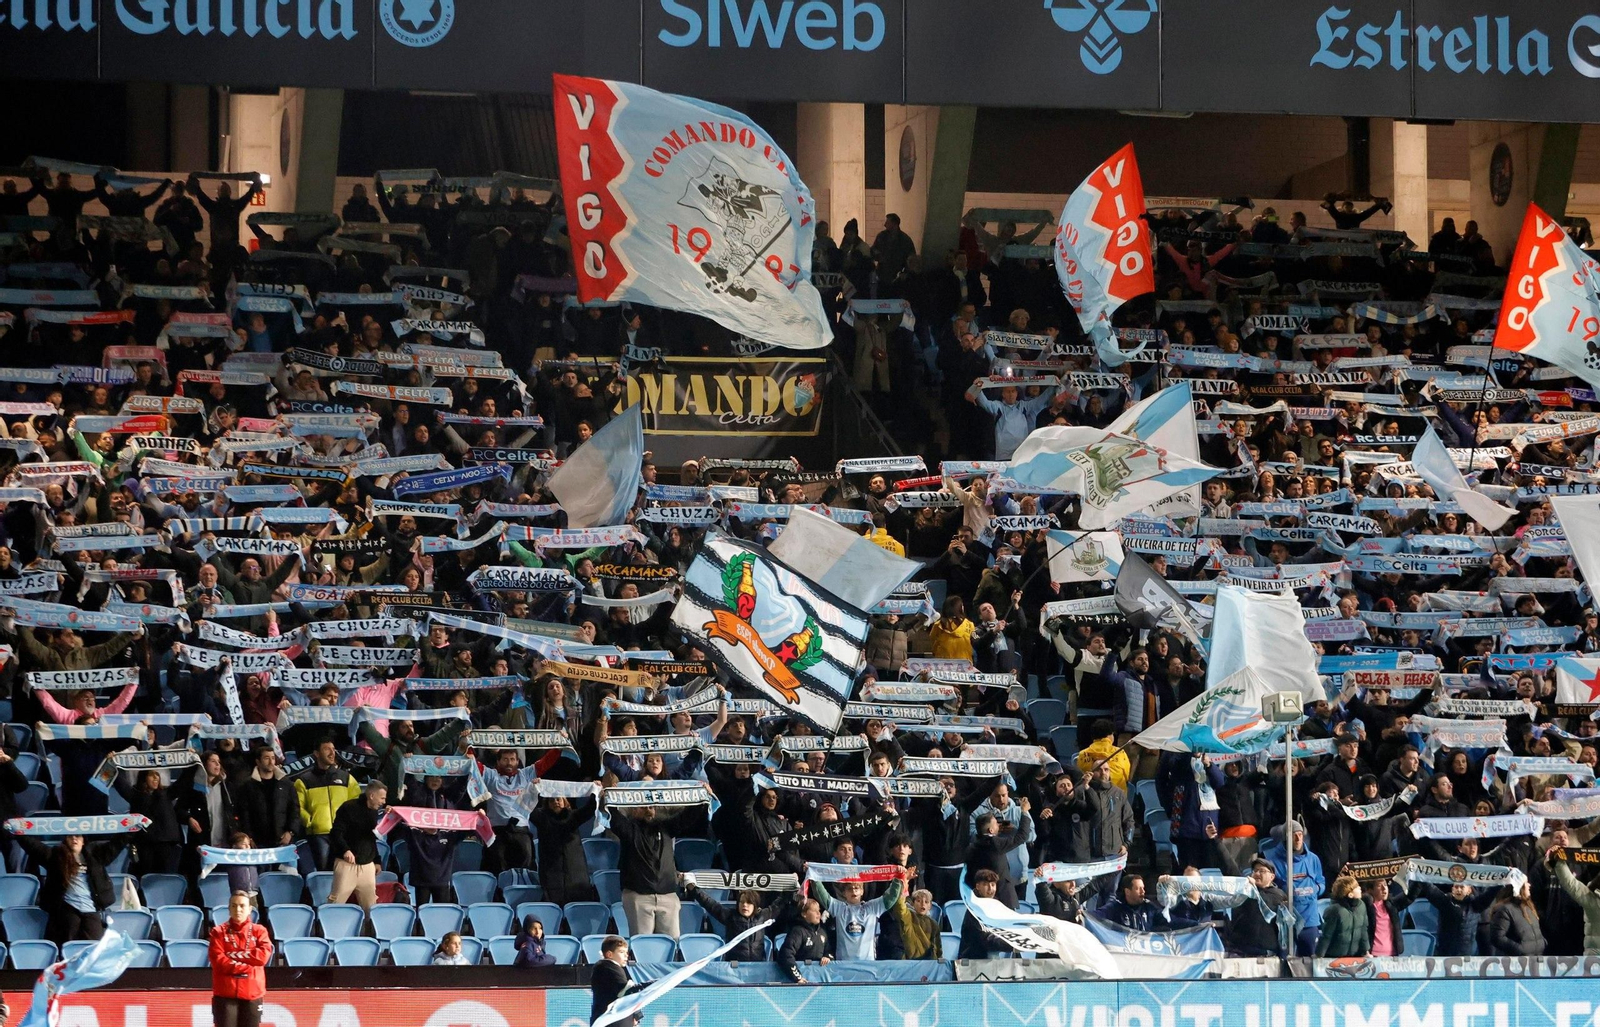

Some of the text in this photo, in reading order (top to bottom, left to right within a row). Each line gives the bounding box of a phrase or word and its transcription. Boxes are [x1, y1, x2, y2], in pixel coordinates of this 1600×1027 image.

[1309, 5, 1553, 77] Estrella
[643, 121, 757, 178] COMANDO
[567, 93, 608, 280] VIGO
[1507, 214, 1556, 331] VIGO
[378, 352, 412, 362] EURO
[433, 366, 511, 379] EURO CELTA
[354, 383, 432, 399] EURO CELTA
[612, 373, 817, 418] OMANDO
[291, 402, 354, 414] RCCelta
[307, 415, 350, 426] CELTA
[717, 410, 782, 426] Celta
[1533, 418, 1599, 438] EURO CELTA
[137, 436, 197, 451] BOINAS
[1376, 434, 1417, 444] CELTA
[473, 450, 538, 462] RCCelta
[373, 502, 449, 516] SEMPRE CELTA
[1260, 528, 1315, 541] RCCelta
[1122, 536, 1197, 552] OLIVEIRA DE TEIS
[1372, 559, 1428, 572] RCCelta
[1231, 576, 1308, 590] OLIVEIRA DE TEIS
[370, 595, 433, 606] REAL CLUB CELTA
[1067, 601, 1095, 615] CELTA
[1301, 606, 1336, 620] DE TEIS
[77, 613, 118, 626] ASPAS
[309, 619, 402, 634] LE-CHUZAS
[636, 664, 708, 675] REAL CLUB CELTA
[774, 774, 870, 793] FEITO NA MADROA
[651, 788, 660, 803] E
[34, 818, 119, 832] RCCelta
[409, 810, 463, 828] CELTA
[1445, 821, 1469, 834] CLUB
[1491, 817, 1521, 832] CELTA
[1575, 853, 1600, 864] REAL
[1350, 866, 1390, 878] REAL CLUB
[721, 872, 772, 889] VIGO
